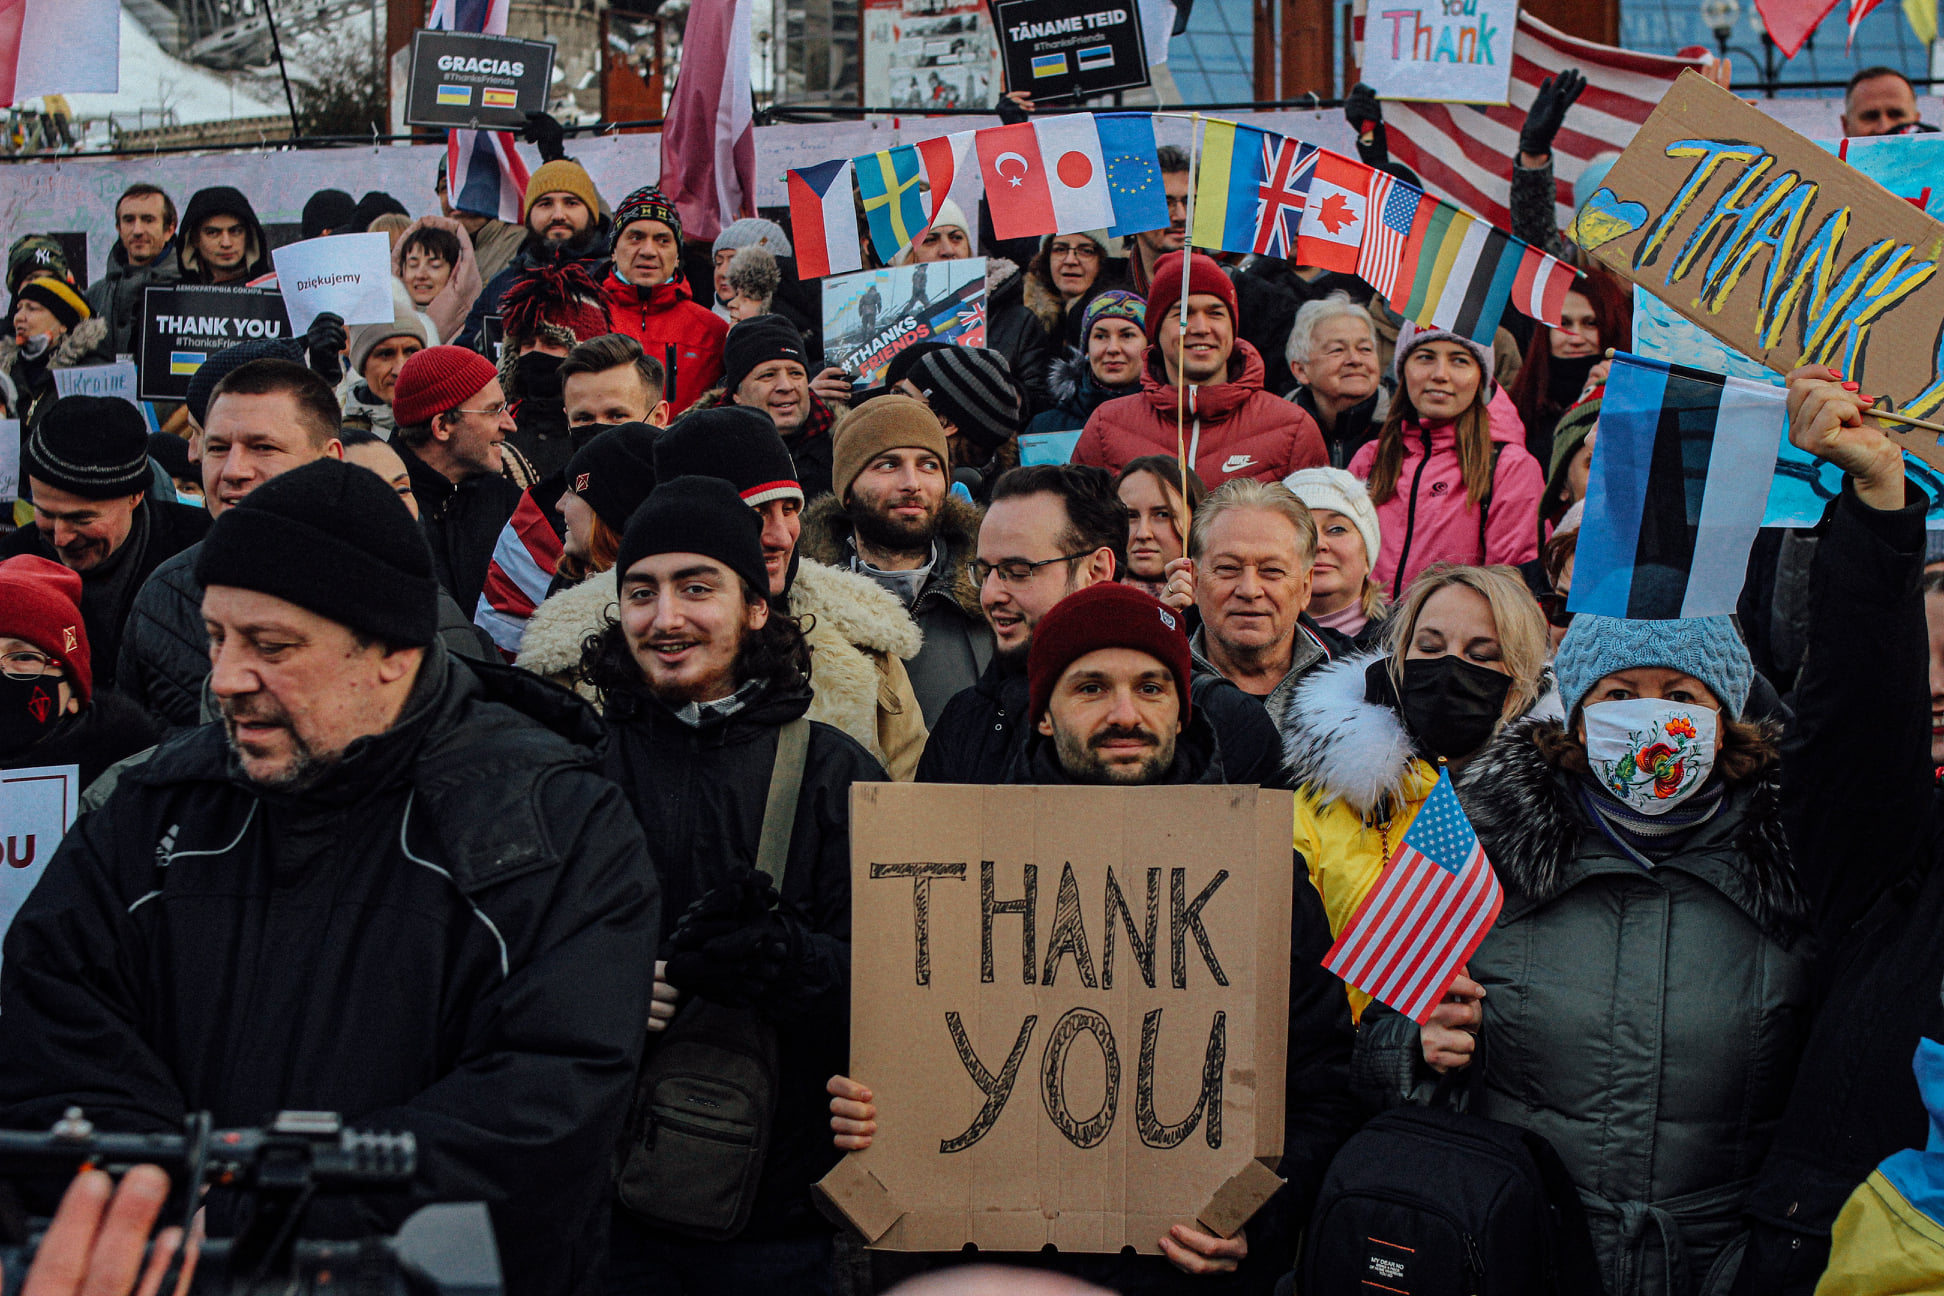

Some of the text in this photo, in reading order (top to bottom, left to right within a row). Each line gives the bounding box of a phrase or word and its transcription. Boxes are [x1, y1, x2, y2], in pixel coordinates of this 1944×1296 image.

[1083, 9, 1127, 29] TEID
[438, 55, 524, 77] GRACIAS
[443, 73, 515, 86] #ThanksFriends
[297, 273, 361, 291] Dziękujemy
[156, 315, 281, 339] THANK YOU
[841, 315, 918, 375] #THANKS
[858, 324, 931, 379] FRIENDS
[1227, 455, 1251, 465] NIKE
[870, 860, 1229, 989] THANK
[940, 1007, 1226, 1153] YOU
